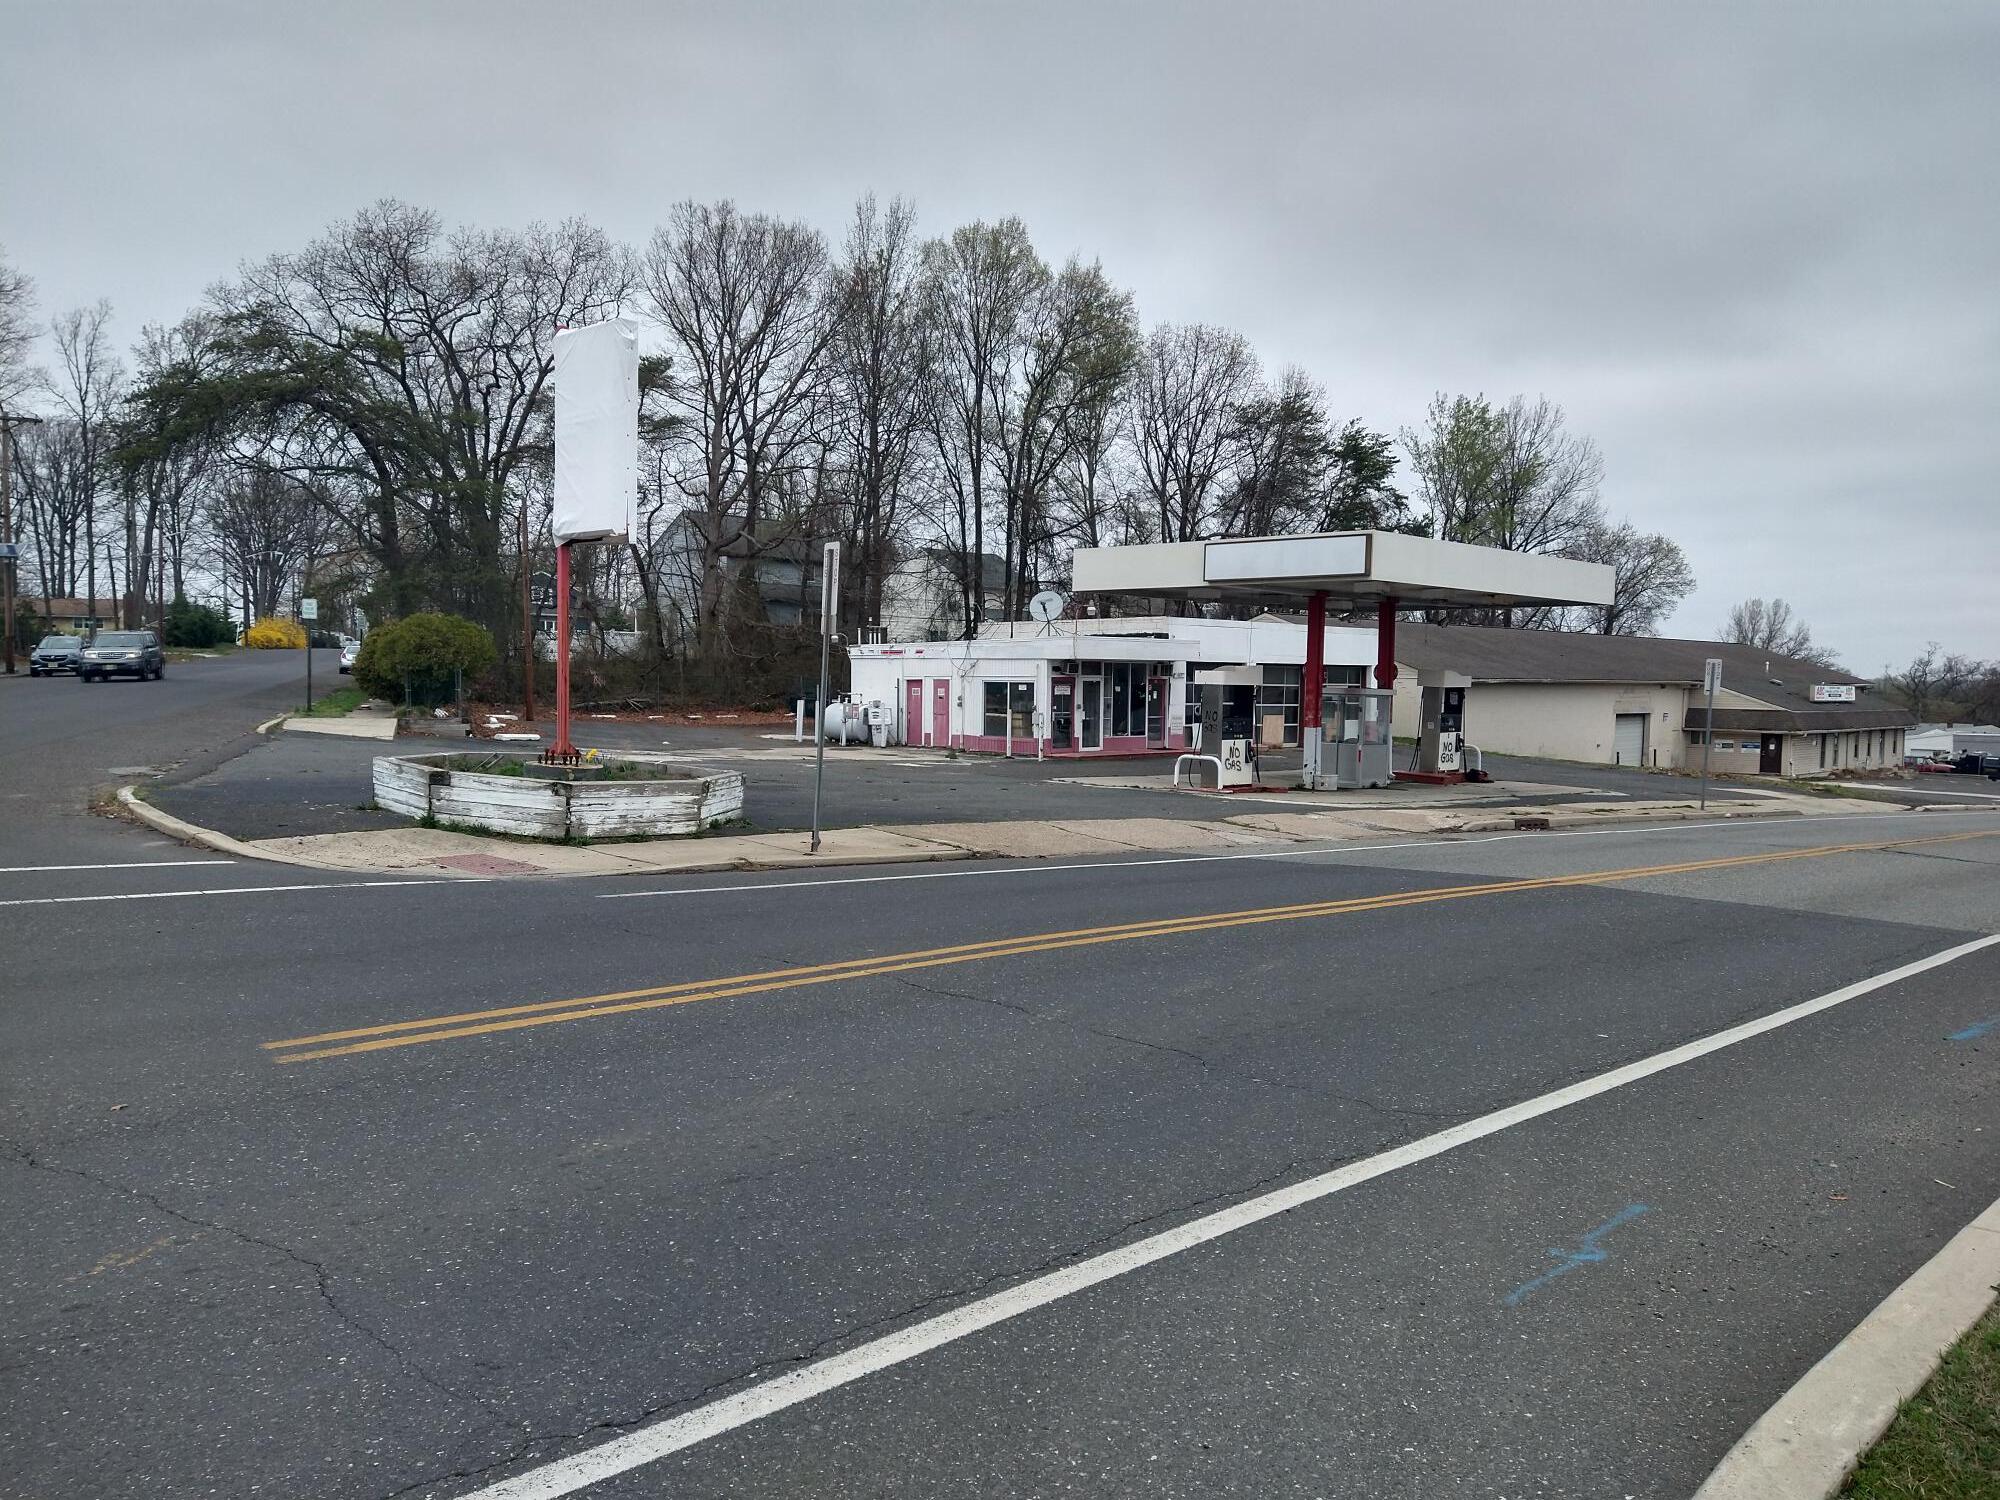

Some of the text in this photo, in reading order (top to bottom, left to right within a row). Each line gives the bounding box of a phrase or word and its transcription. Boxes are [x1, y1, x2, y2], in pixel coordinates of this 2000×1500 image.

[1205, 710, 1218, 721] NO
[1229, 746, 1240, 758] NO
[1443, 741, 1452, 752] NO
[1225, 758, 1241, 771] GAS
